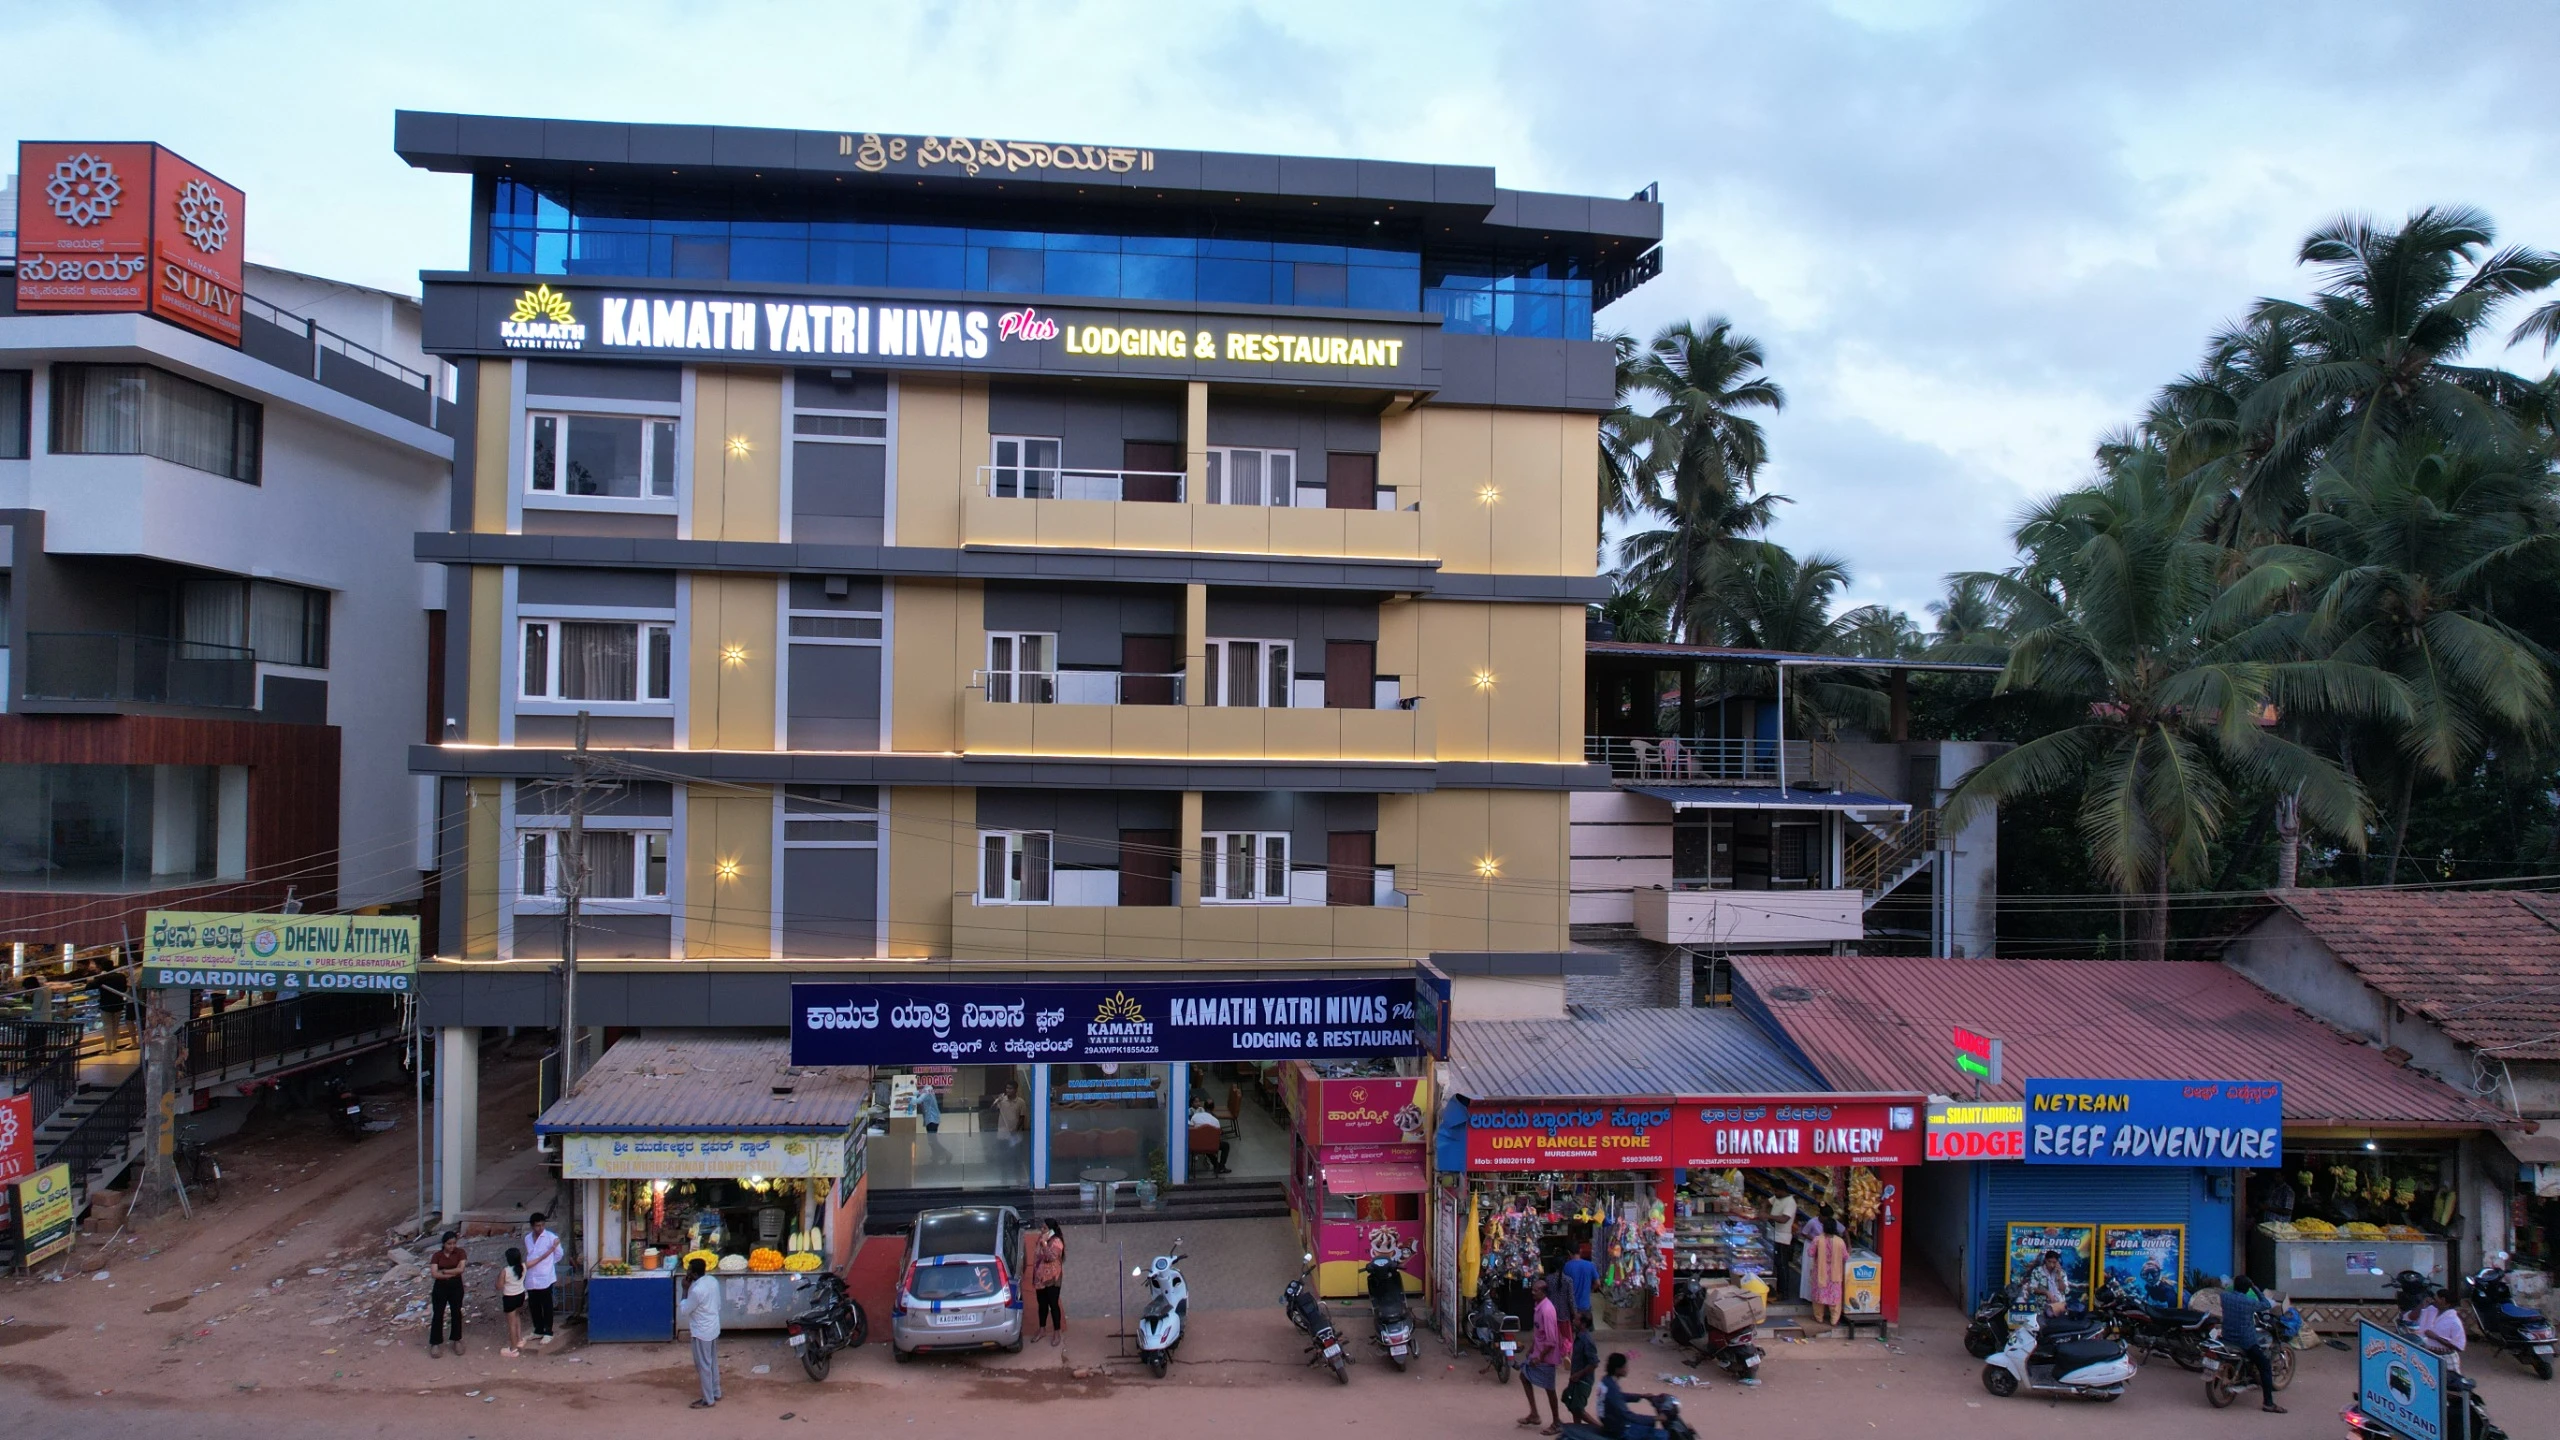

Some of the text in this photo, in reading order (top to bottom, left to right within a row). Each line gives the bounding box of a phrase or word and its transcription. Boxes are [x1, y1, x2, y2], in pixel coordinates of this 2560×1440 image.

[18, 252, 146, 281] ಸುಜಯ್
[164, 264, 238, 317] SUJAY
[500, 321, 586, 341] KAMATH
[602, 297, 989, 359] KAMATH YATRI NIVAS
[998, 307, 1059, 342] Plus
[505, 339, 581, 350] YATRI NIVAS
[1066, 326, 1403, 367] LODGING & RESTAURANT
[152, 918, 246, 957] ಧೇನು ಆತಿಥ್ಯ
[285, 926, 411, 954] DHENU ATITHYA
[315, 958, 407, 968] PURE VEG RESTAURANT
[159, 970, 408, 990] BOARDING & LODGING
[806, 997, 1065, 1038] ಕಾಮತ ಯಾತ್ರಿ ನಿವಾಸ ಪ್ಲಸ್
[1170, 995, 1415, 1027] KAMATH YATRI NIVAS Plu
[1087, 1022, 1154, 1036] KAMATH
[988, 1041, 999, 1053] &
[1089, 1036, 1152, 1044] YATRI NIVAS
[1232, 1032, 1302, 1049] LODGING
[1307, 1032, 1319, 1048] &
[1953, 1026, 1991, 1060] LODGE
[916, 1075, 953, 1086] LODGING
[2034, 1094, 2130, 1112] NETRANI
[1470, 1109, 1529, 1129] ಉದಯ
[1946, 1106, 2023, 1124] SHANTADURGA
[1492, 1135, 1650, 1149] UDAY BANGLE STORE
[1716, 1128, 1884, 1154] BHARATH BAKERY
[1927, 1131, 2023, 1157] LODGE
[2034, 1123, 2278, 1160] REEF ADVENTURE
[606, 1161, 630, 1173] SHRI
[707, 1160, 747, 1172] FLOWER
[750, 1160, 777, 1172] STALL
[2049, 1238, 2080, 1247] DIVING
[2141, 1240, 2172, 1248] DIVING
[2366, 1390, 2396, 1413] AUTO
[2398, 1406, 2437, 1435] STAND
